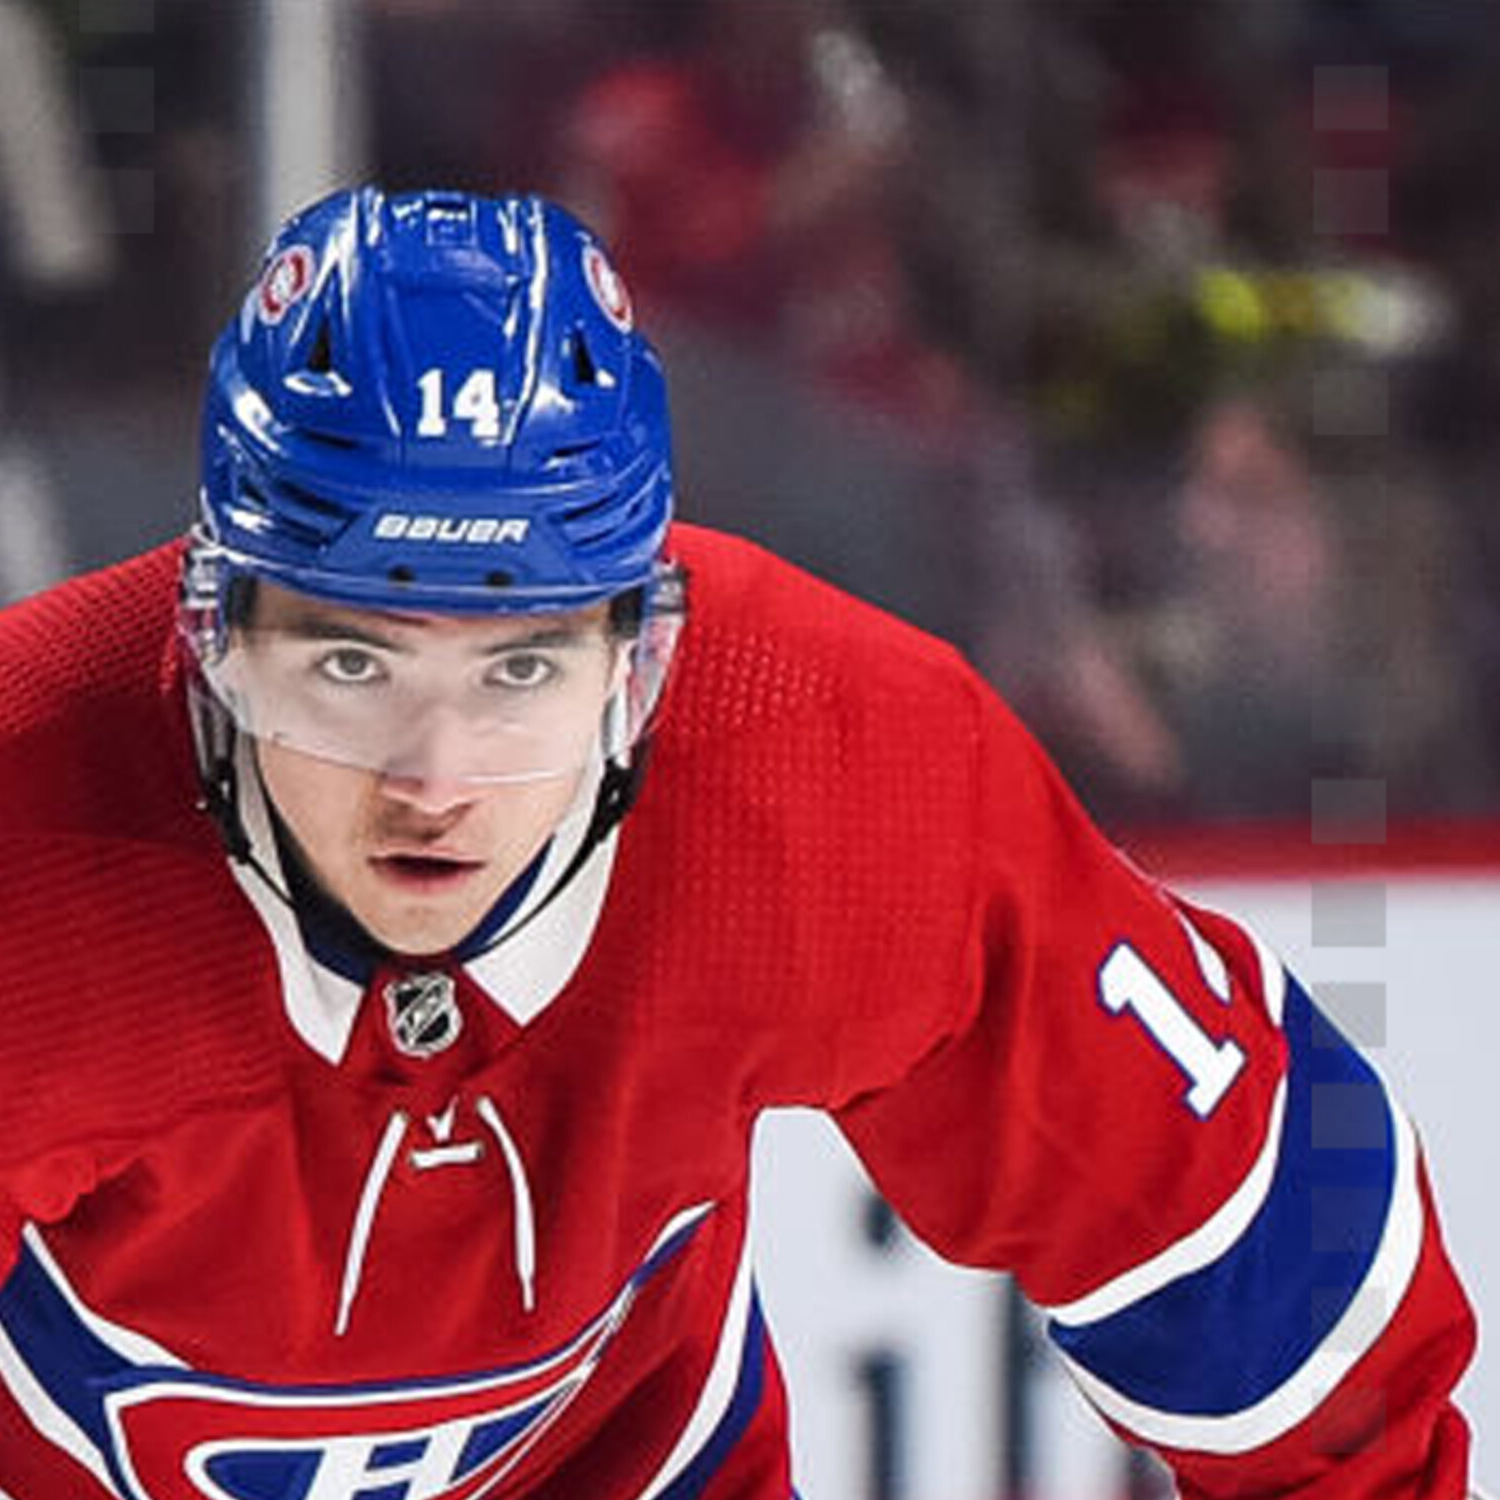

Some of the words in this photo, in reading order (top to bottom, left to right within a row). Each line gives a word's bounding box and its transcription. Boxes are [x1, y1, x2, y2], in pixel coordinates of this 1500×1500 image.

[417, 369, 501, 438] 14
[375, 514, 528, 542] BAUER
[1097, 912, 1245, 1121] 1
